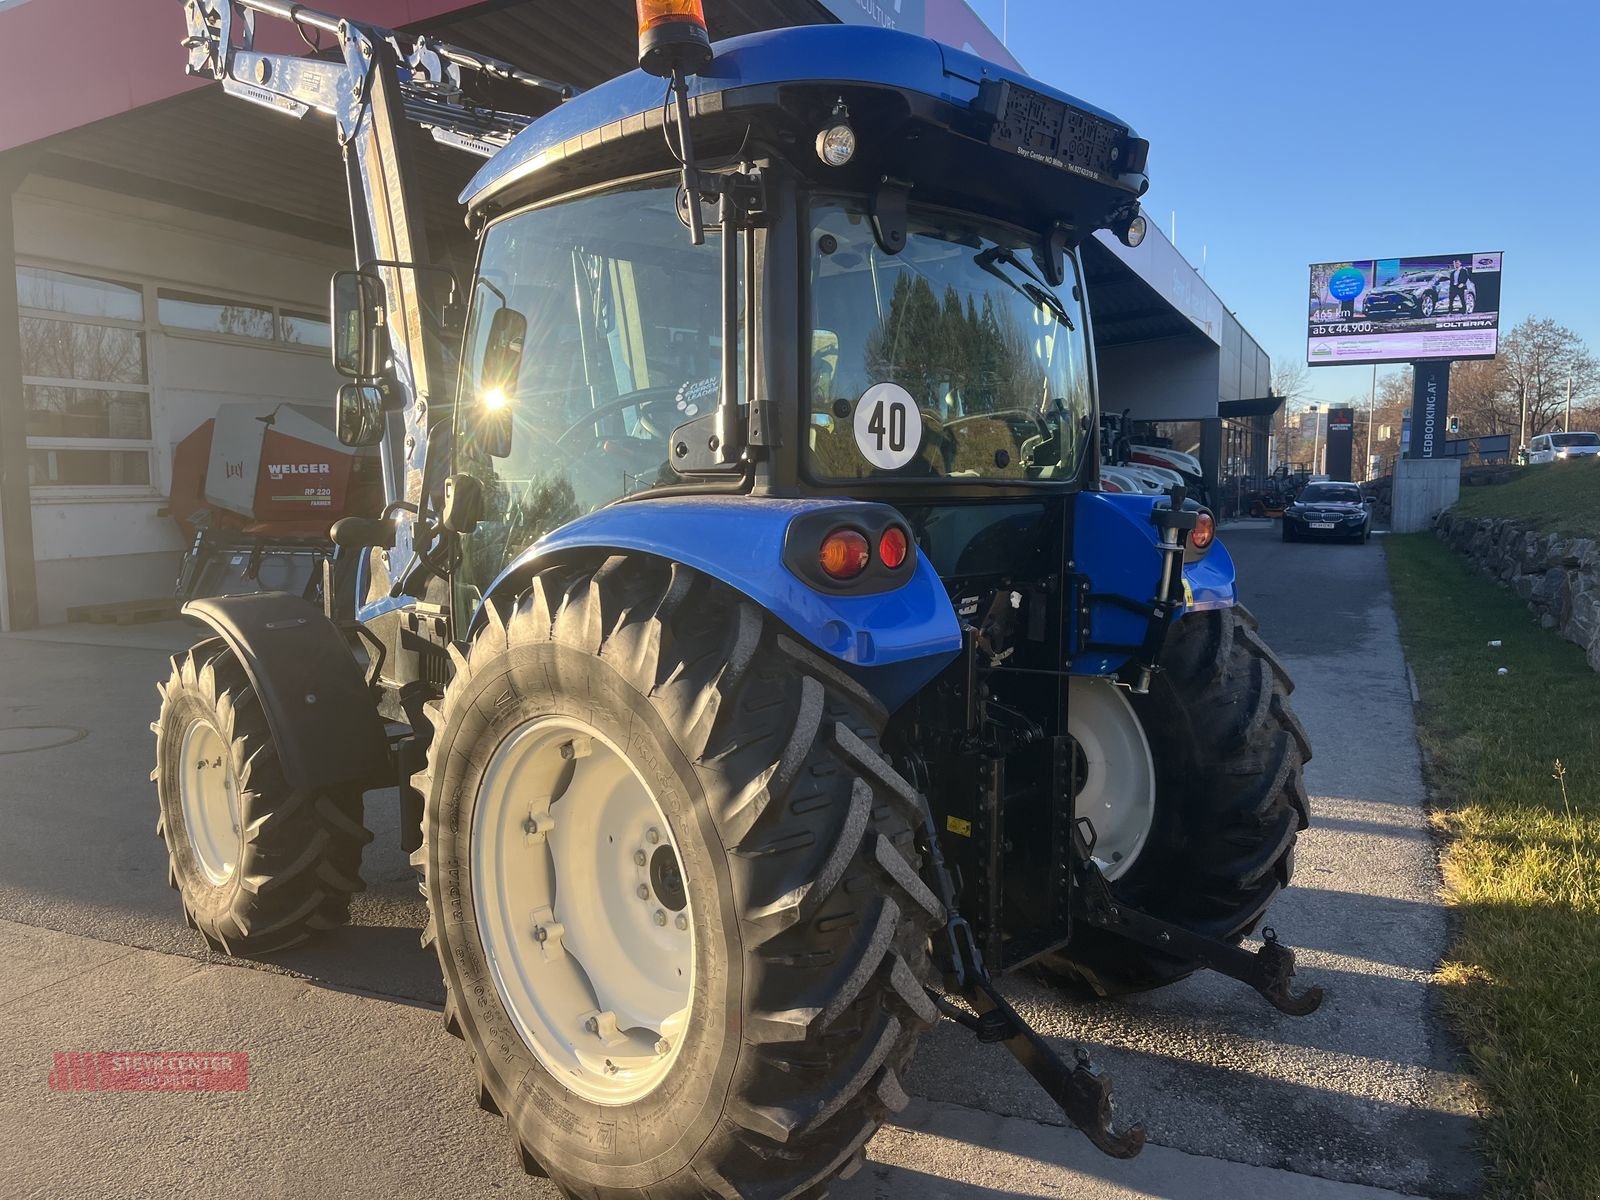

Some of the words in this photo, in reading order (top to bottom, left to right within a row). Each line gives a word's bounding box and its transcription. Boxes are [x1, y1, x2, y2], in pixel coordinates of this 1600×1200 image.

[856, 0, 896, 30] CULTURE
[1335, 308, 1351, 318] km
[1312, 324, 1326, 335] ab
[1435, 320, 1493, 329] SOLTERRA
[1423, 381, 1437, 458] LEDBOOKING.AT
[868, 401, 906, 452] 40
[268, 463, 330, 474] WELGER
[304, 488, 315, 496] RP
[316, 488, 331, 496] 220
